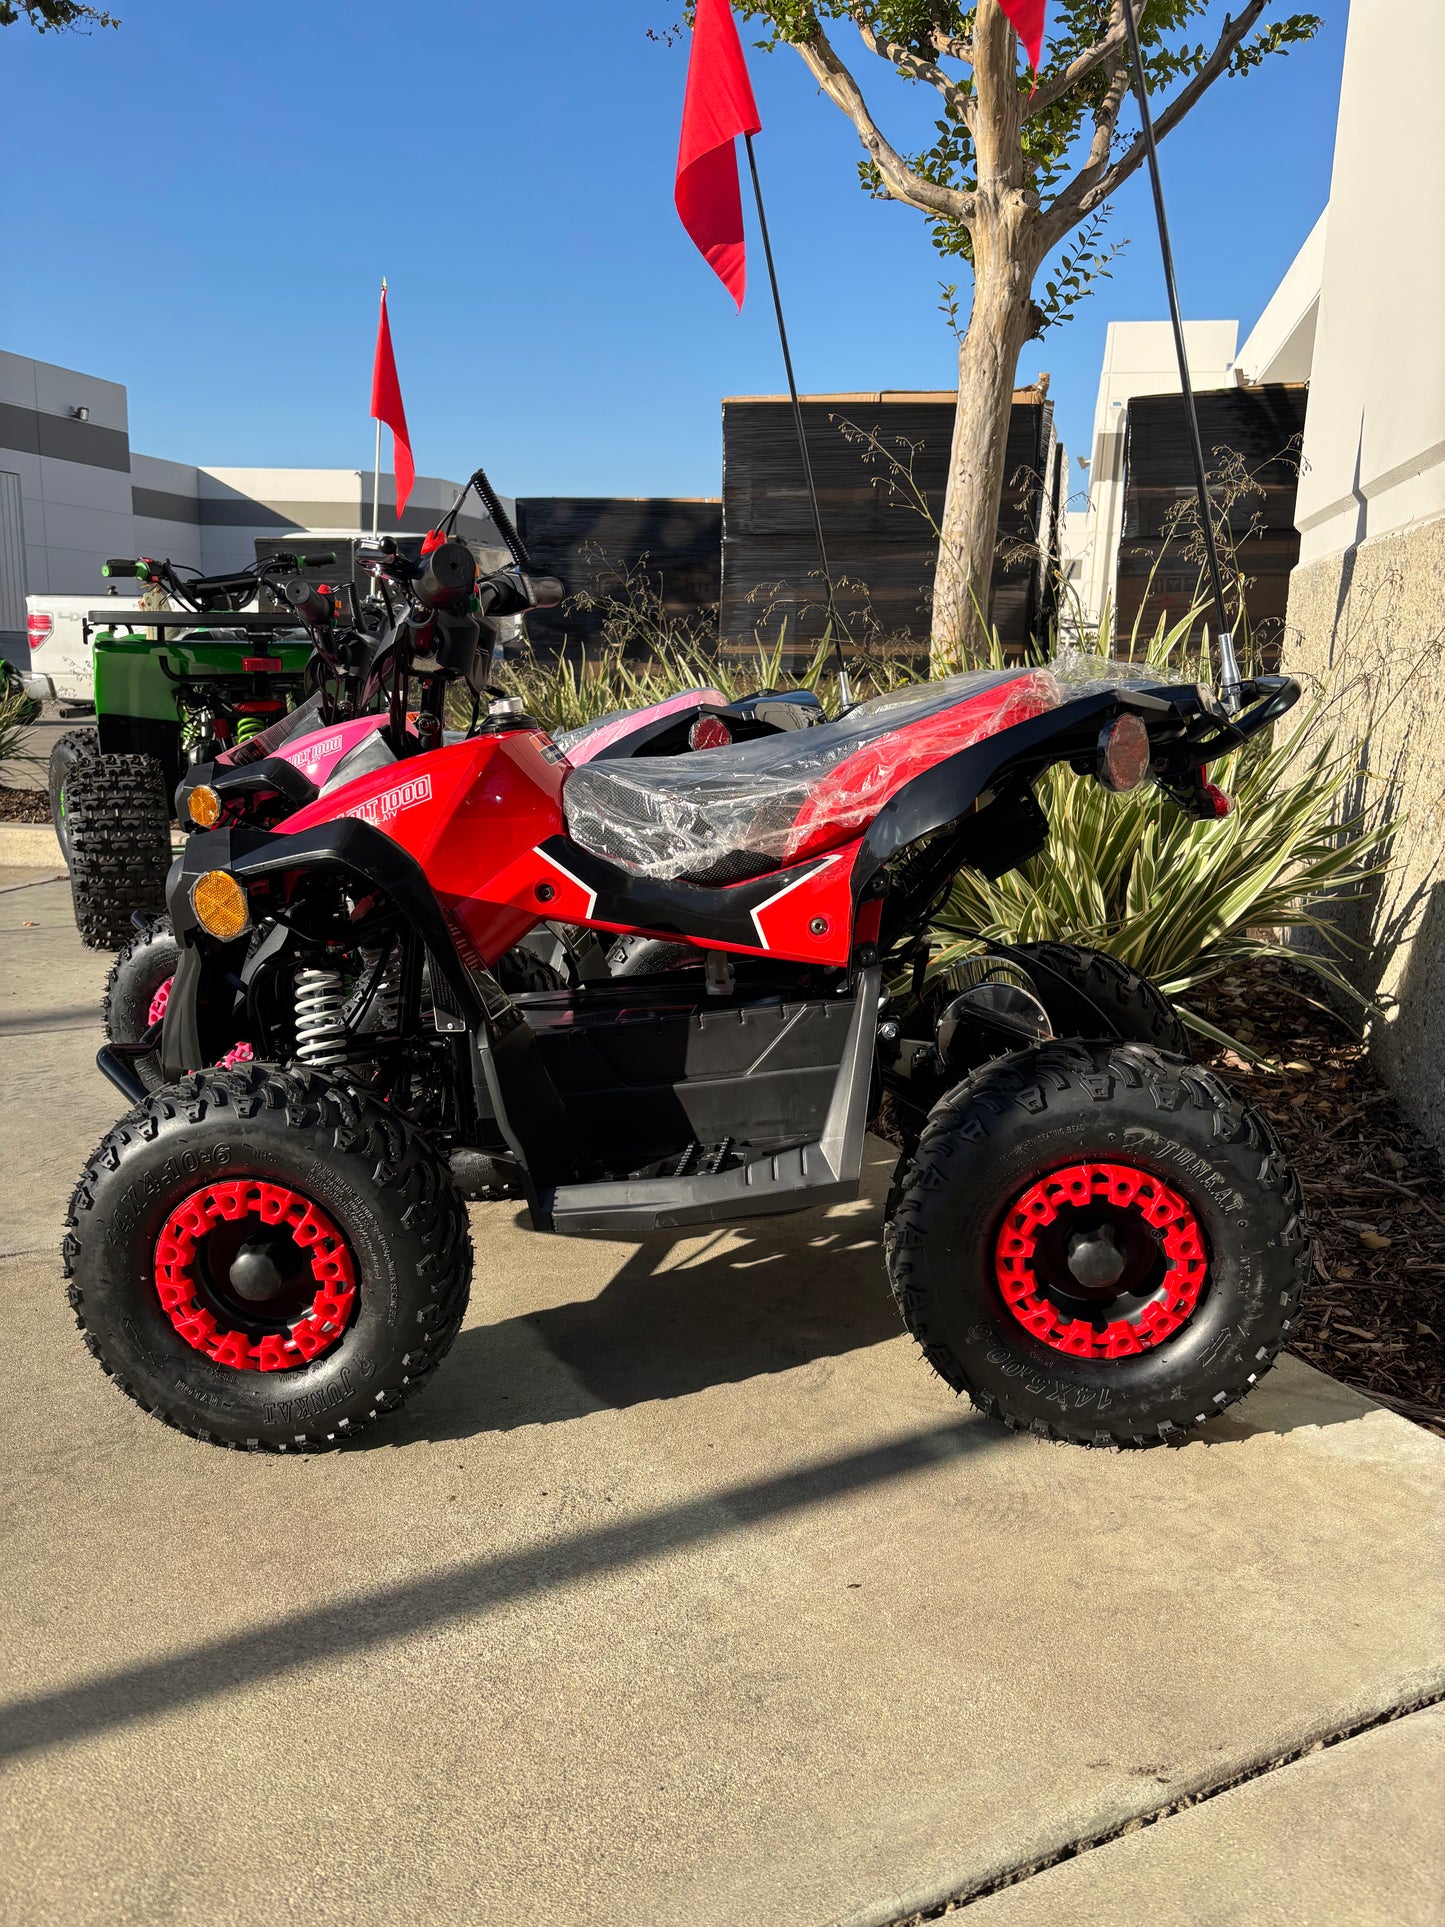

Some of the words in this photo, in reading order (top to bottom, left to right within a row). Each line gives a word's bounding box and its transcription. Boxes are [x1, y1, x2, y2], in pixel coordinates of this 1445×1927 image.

[381, 778, 429, 815] 1000
[375, 809, 398, 826] E-ATV
[262, 1366, 355, 1424] JUNKAI
